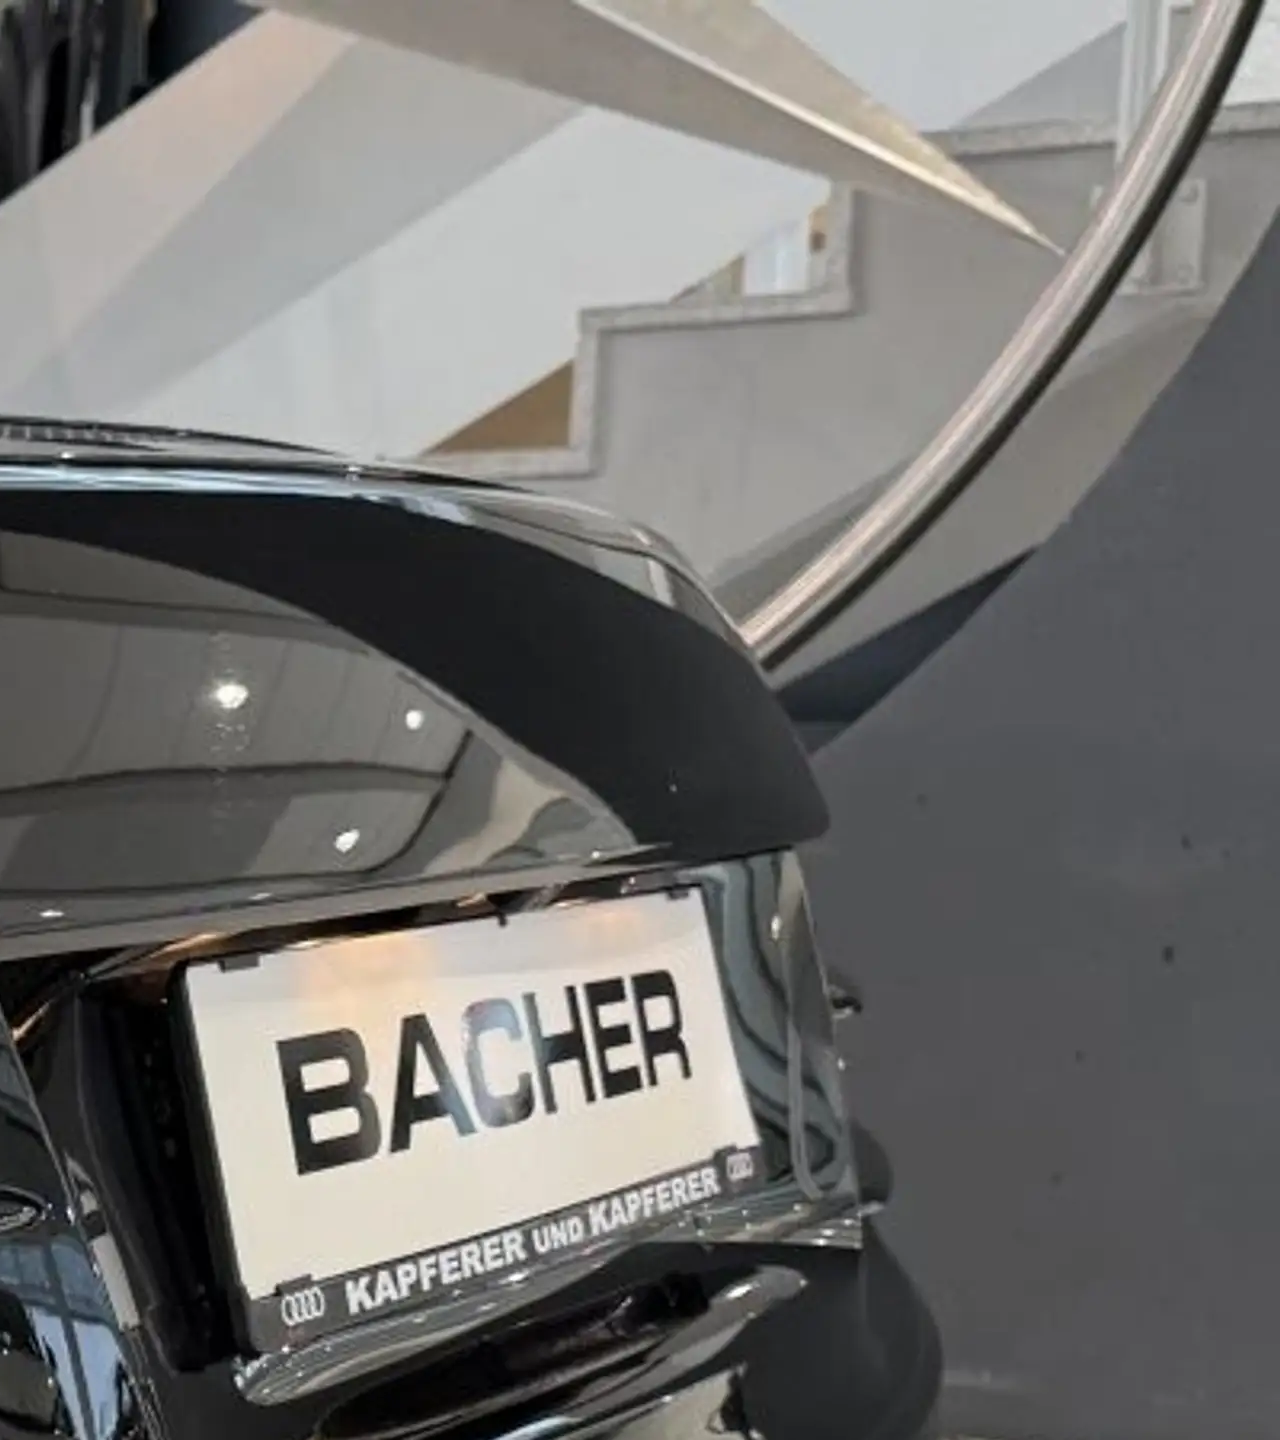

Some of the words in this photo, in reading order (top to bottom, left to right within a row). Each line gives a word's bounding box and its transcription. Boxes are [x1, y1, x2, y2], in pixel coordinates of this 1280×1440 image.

[276, 969, 691, 1175] BACHER
[345, 1233, 527, 1315] KAPFERER
[532, 1215, 583, 1255] UND
[588, 1166, 720, 1233] KAPFERER
